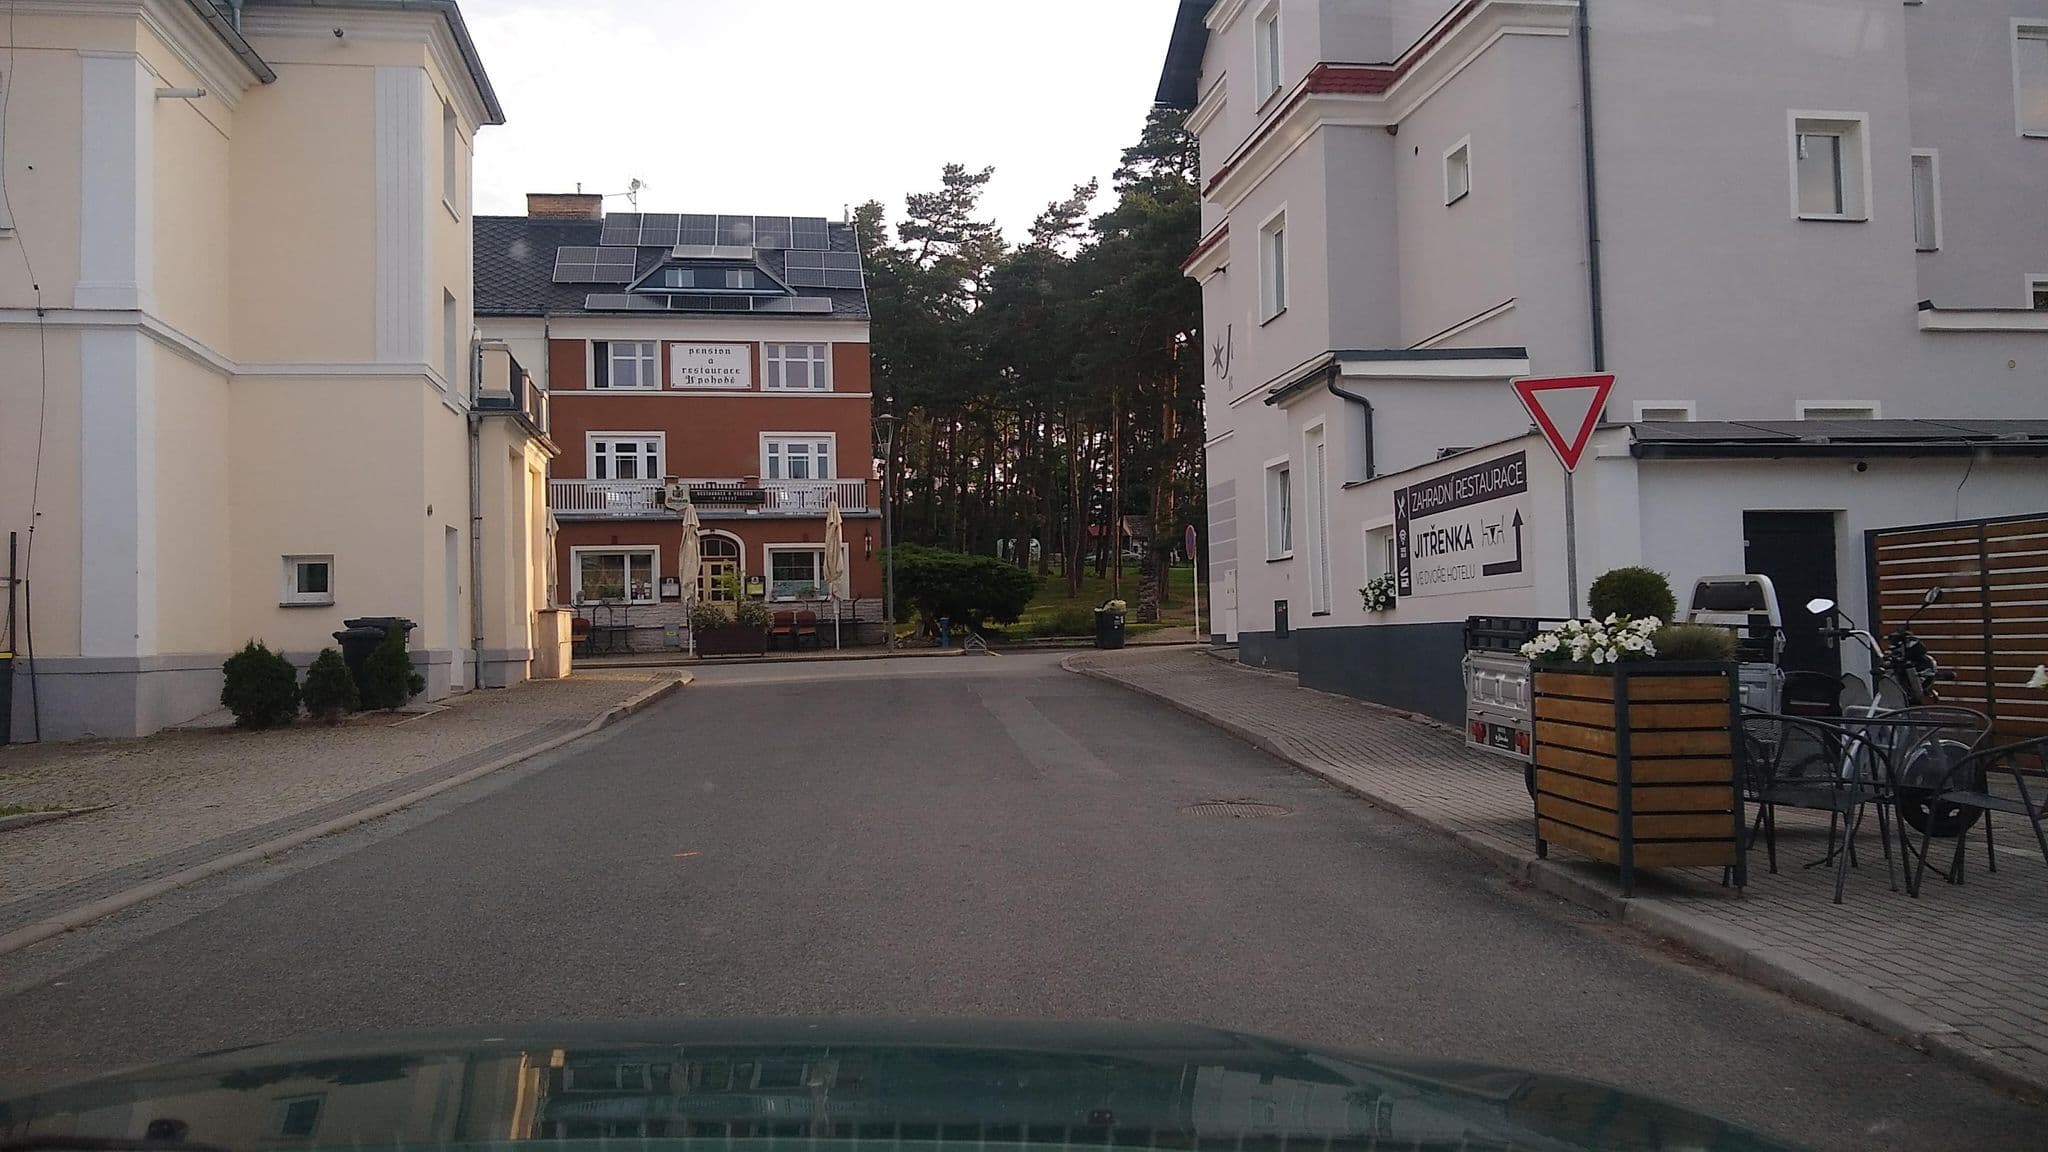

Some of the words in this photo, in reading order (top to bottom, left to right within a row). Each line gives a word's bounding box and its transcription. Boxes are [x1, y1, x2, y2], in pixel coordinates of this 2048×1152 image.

[689, 348, 731, 357] pension
[682, 367, 741, 375] restaurace
[1411, 476, 1455, 512] ZAHRADNÍ
[1456, 461, 1523, 501] RESTAURACE
[1414, 523, 1474, 559] JITŘENKA
[1447, 563, 1476, 583] HOTELU
